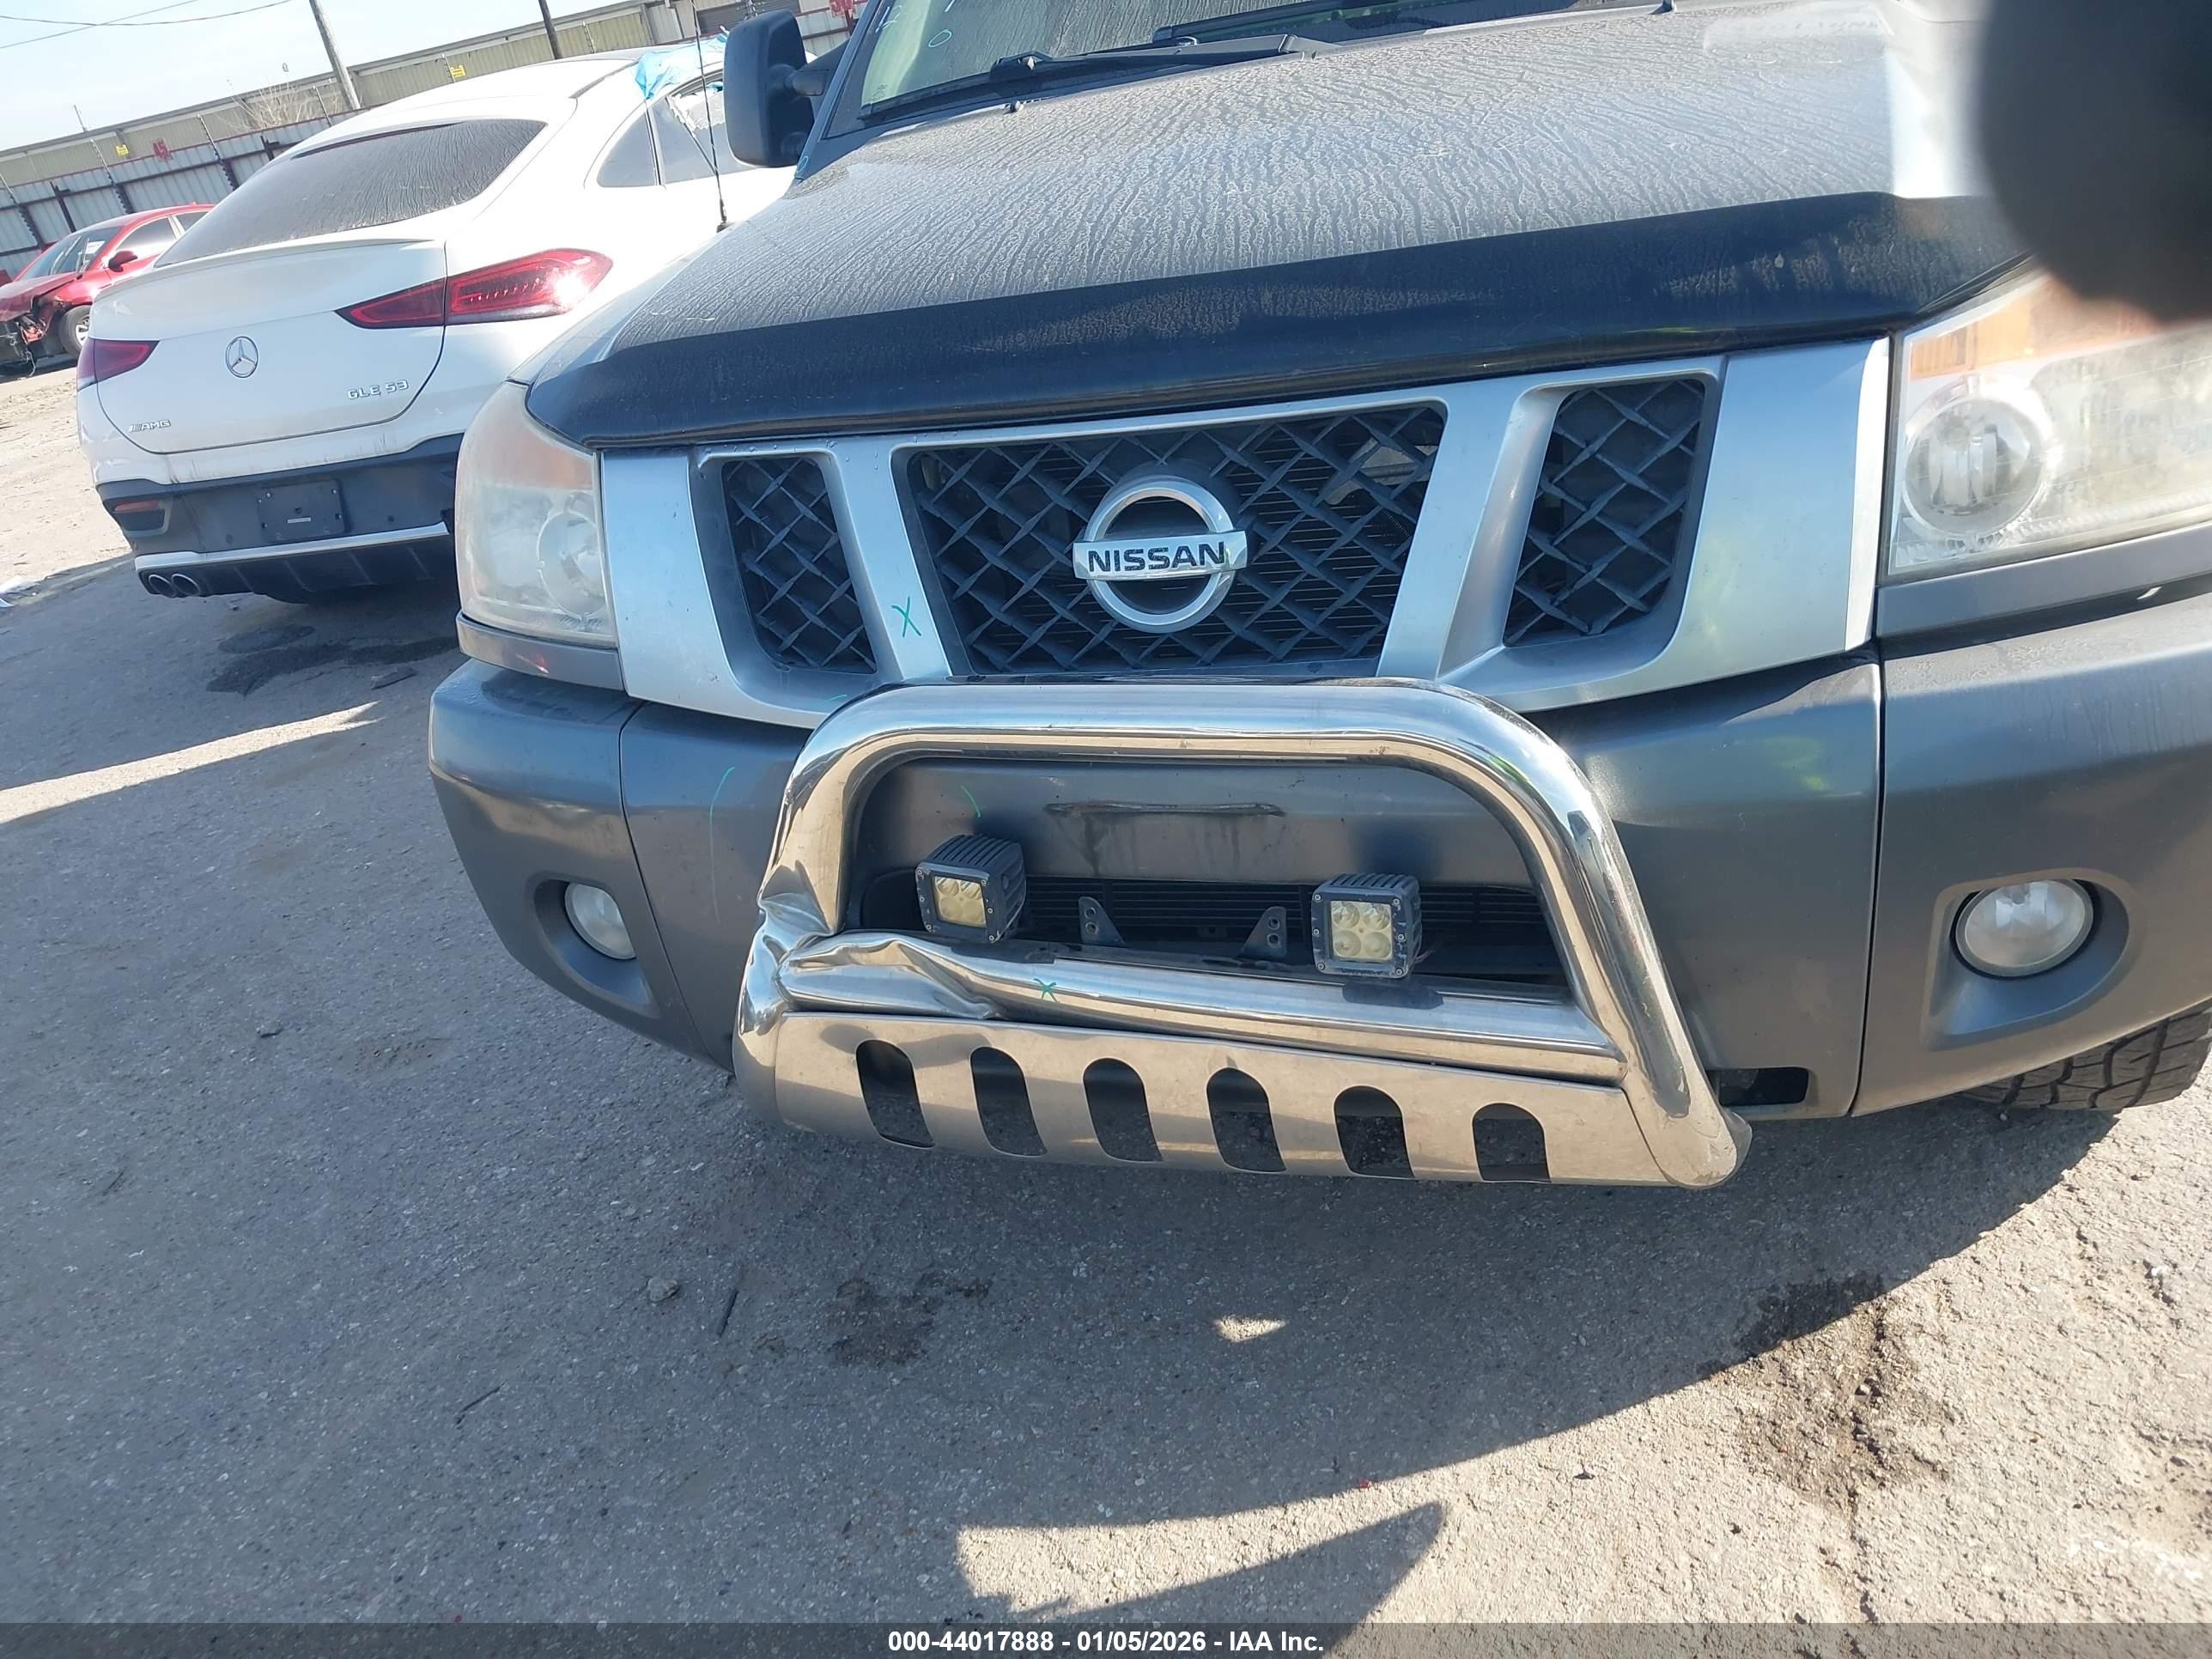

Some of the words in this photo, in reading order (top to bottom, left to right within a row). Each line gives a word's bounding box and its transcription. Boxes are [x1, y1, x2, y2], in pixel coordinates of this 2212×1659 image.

[348, 385, 381, 400] GLE
[385, 380, 410, 393] 53
[141, 420, 171, 430] AMG
[1087, 541, 1225, 573] NISSAN
